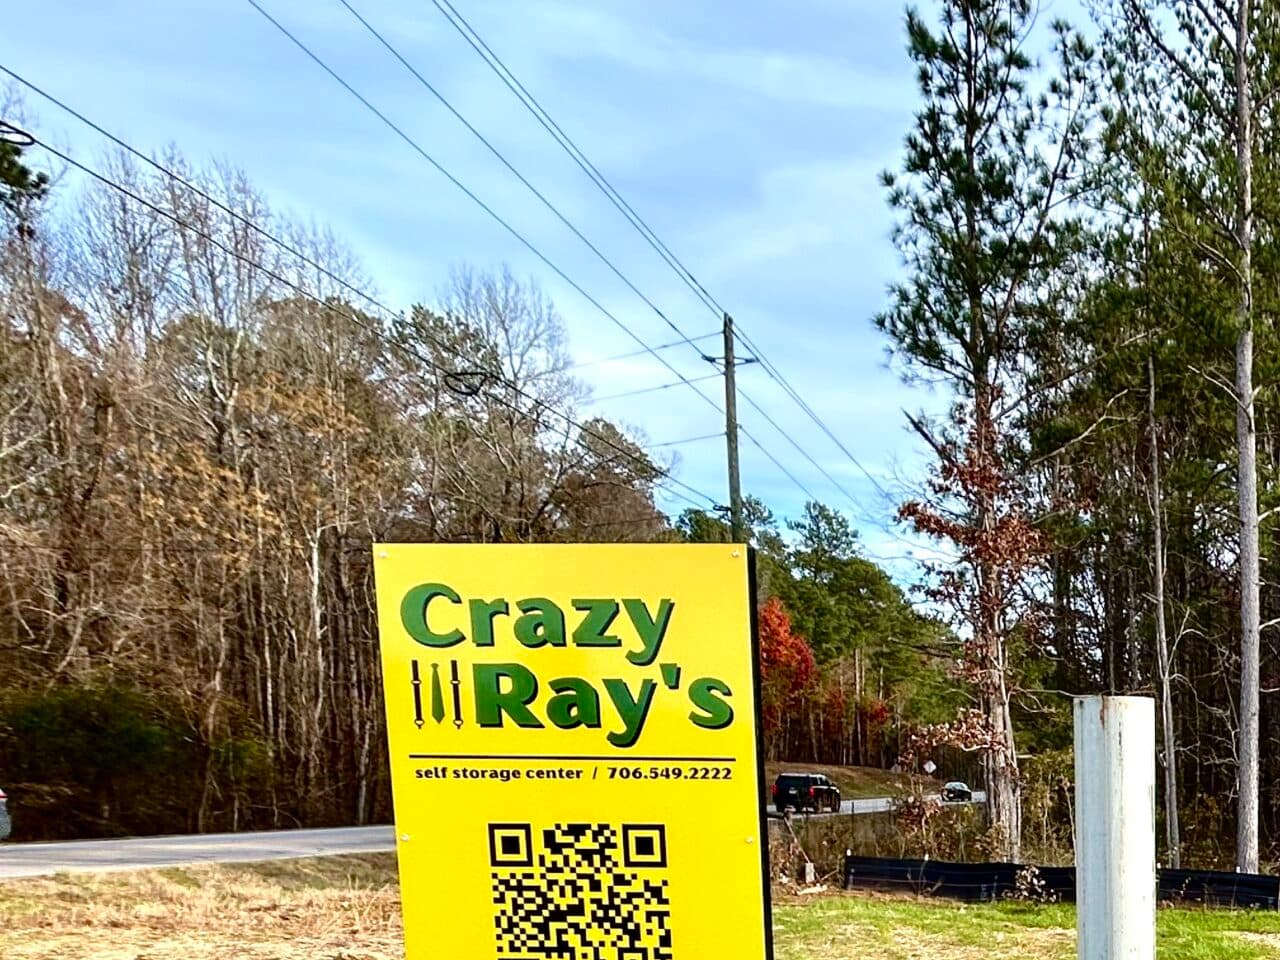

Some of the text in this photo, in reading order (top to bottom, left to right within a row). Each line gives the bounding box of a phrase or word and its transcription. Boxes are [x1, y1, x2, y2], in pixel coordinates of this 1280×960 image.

[400, 582, 675, 666] Crazy
[472, 663, 735, 748] Ray's
[415, 767, 733, 782] self storage center / 706.549.2222
